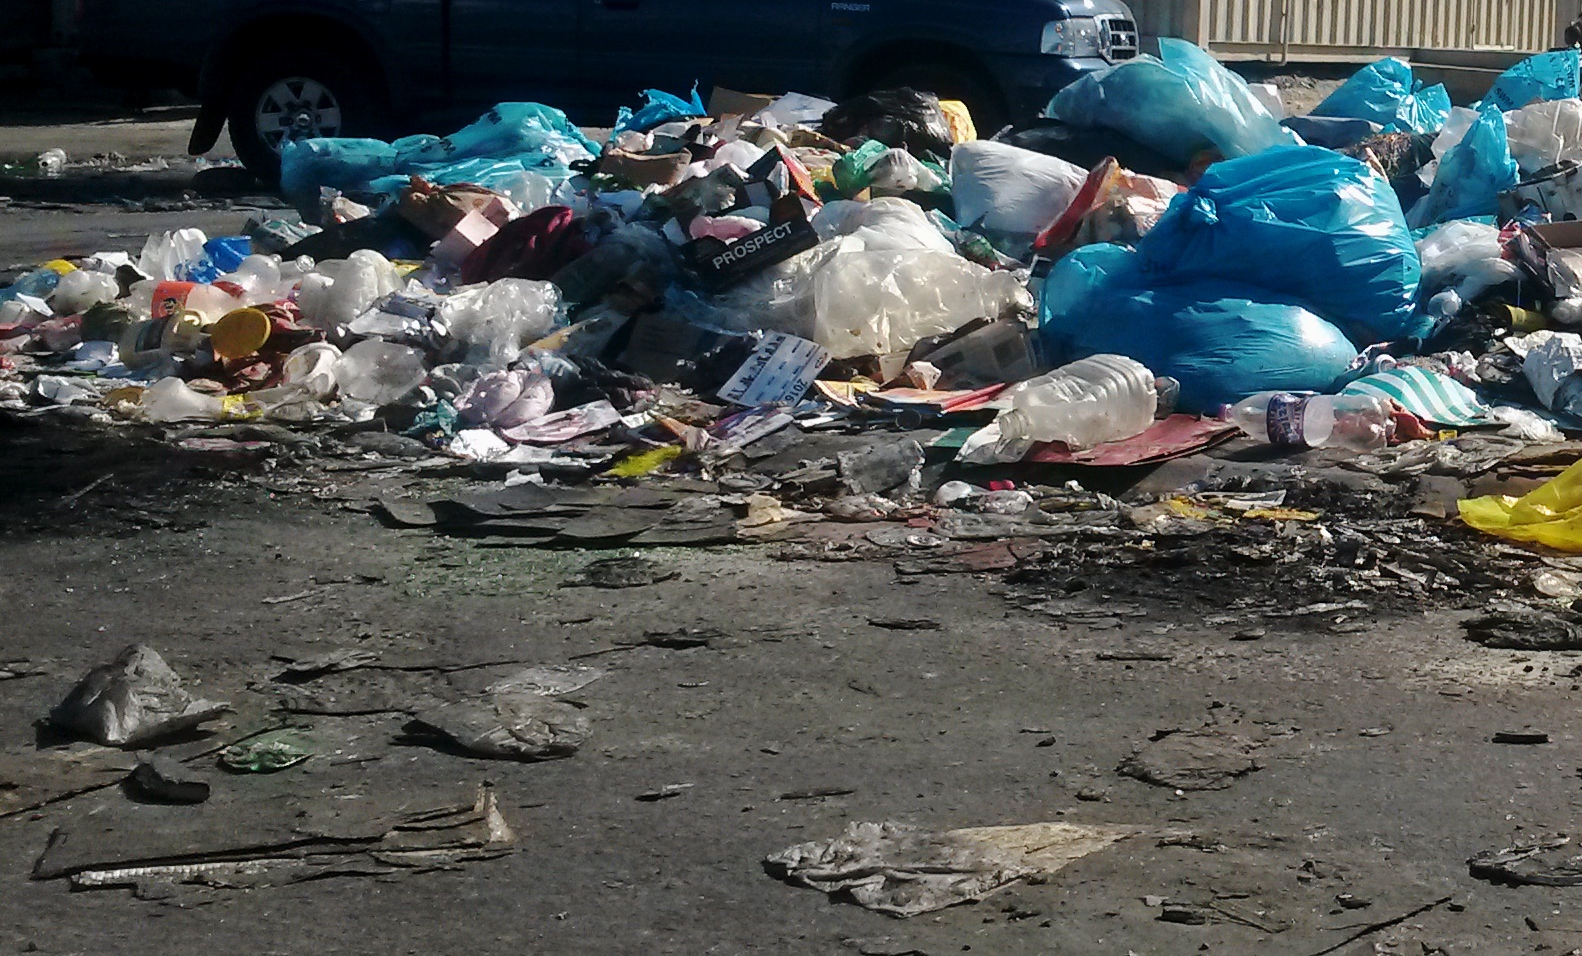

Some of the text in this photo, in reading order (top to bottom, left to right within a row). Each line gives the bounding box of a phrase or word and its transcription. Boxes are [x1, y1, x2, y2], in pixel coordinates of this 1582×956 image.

[831, 2, 870, 12] RANGER
[711, 220, 793, 271] PROSPECT
[784, 378, 808, 404] 2016
